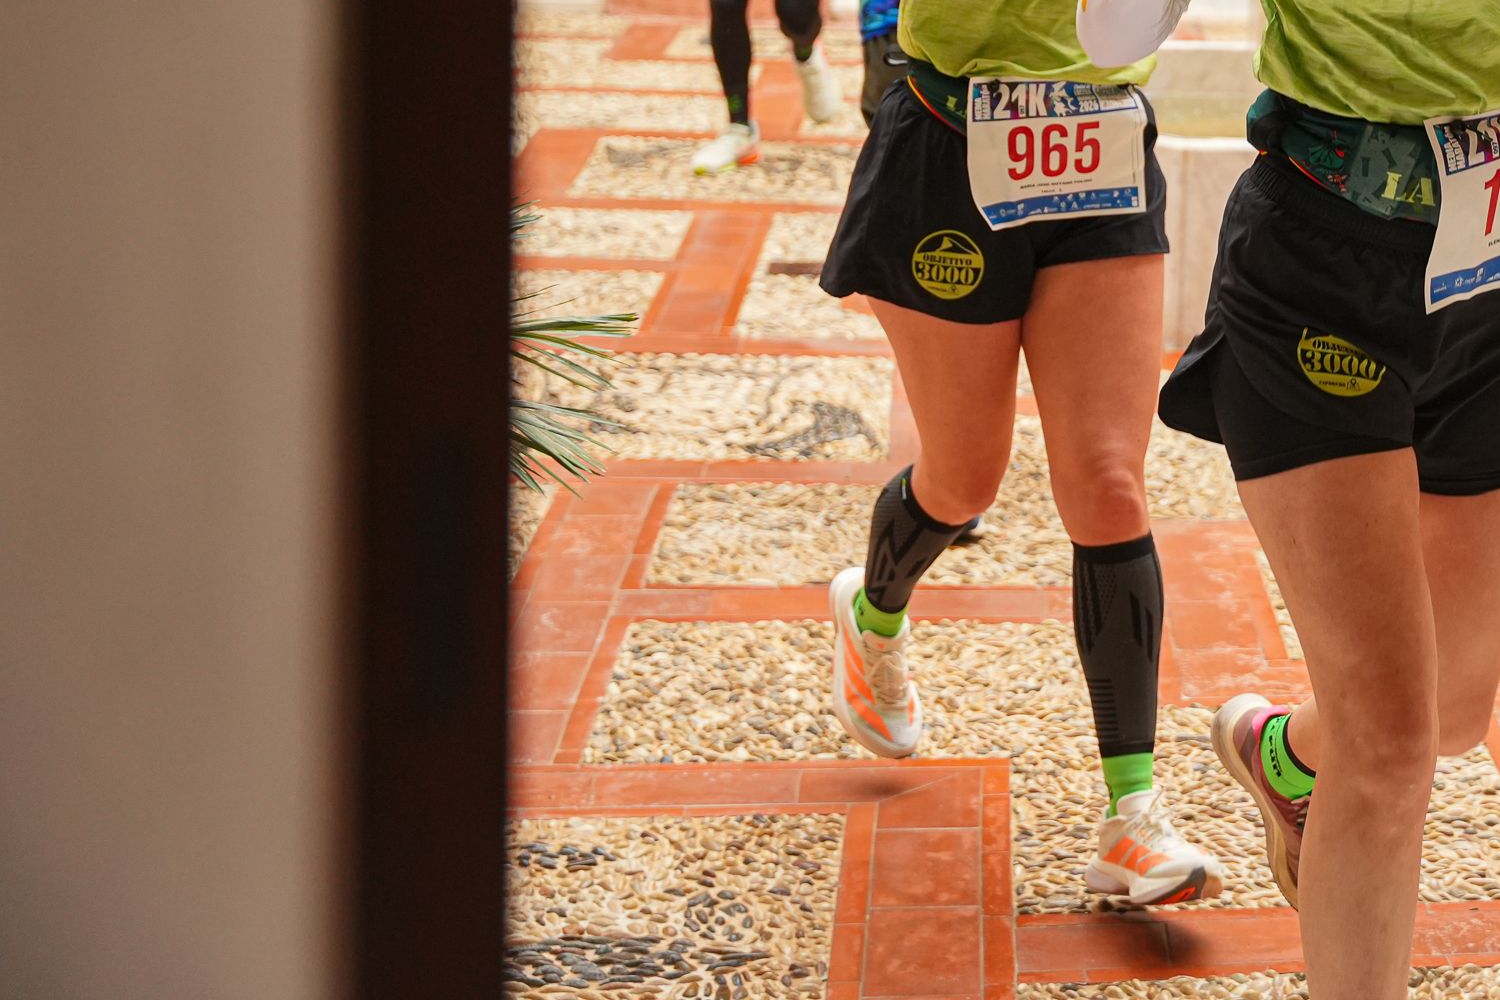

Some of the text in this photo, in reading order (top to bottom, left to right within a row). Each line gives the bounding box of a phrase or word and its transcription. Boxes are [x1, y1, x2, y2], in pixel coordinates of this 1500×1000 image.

[993, 82, 1048, 119] 21K
[1007, 121, 1101, 181] 965
[916, 262, 974, 285] 3000
[1306, 350, 1377, 378] 3000
